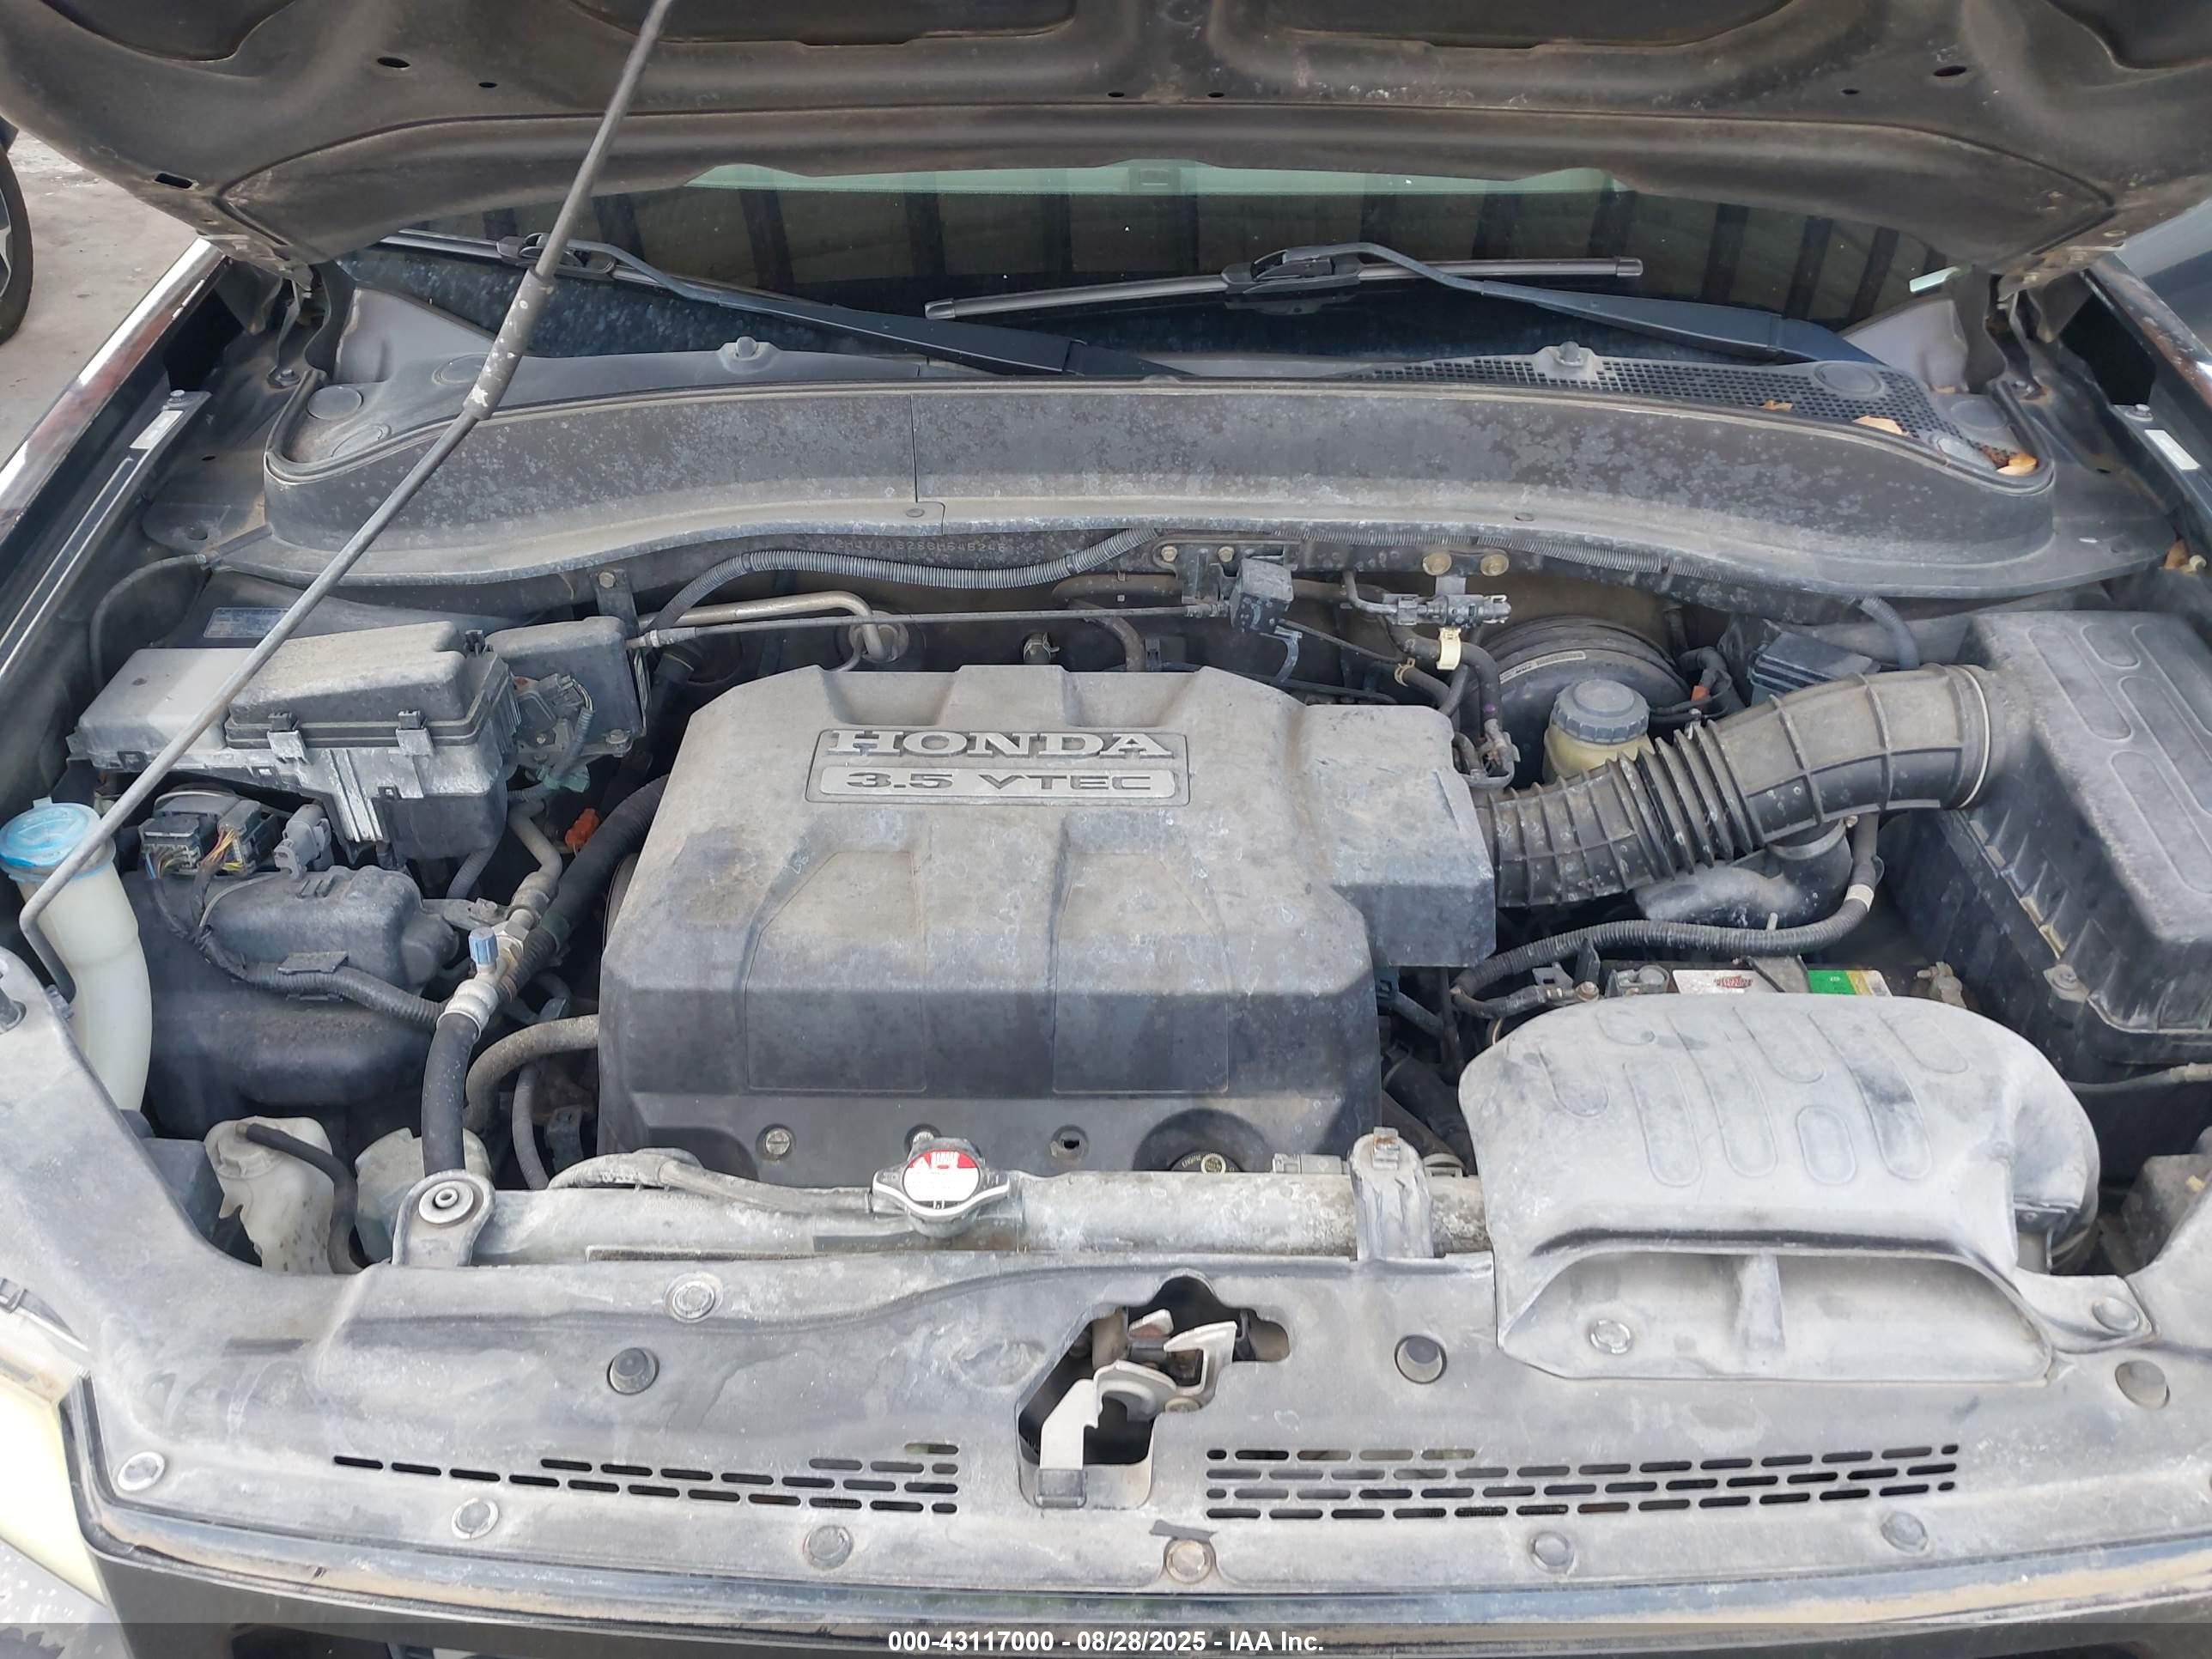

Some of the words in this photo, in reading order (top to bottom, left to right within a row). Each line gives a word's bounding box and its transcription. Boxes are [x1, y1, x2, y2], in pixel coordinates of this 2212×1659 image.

[827, 730, 1176, 759] HONDA
[847, 771, 953, 790] 3.5
[978, 774, 1152, 791] VTEC
